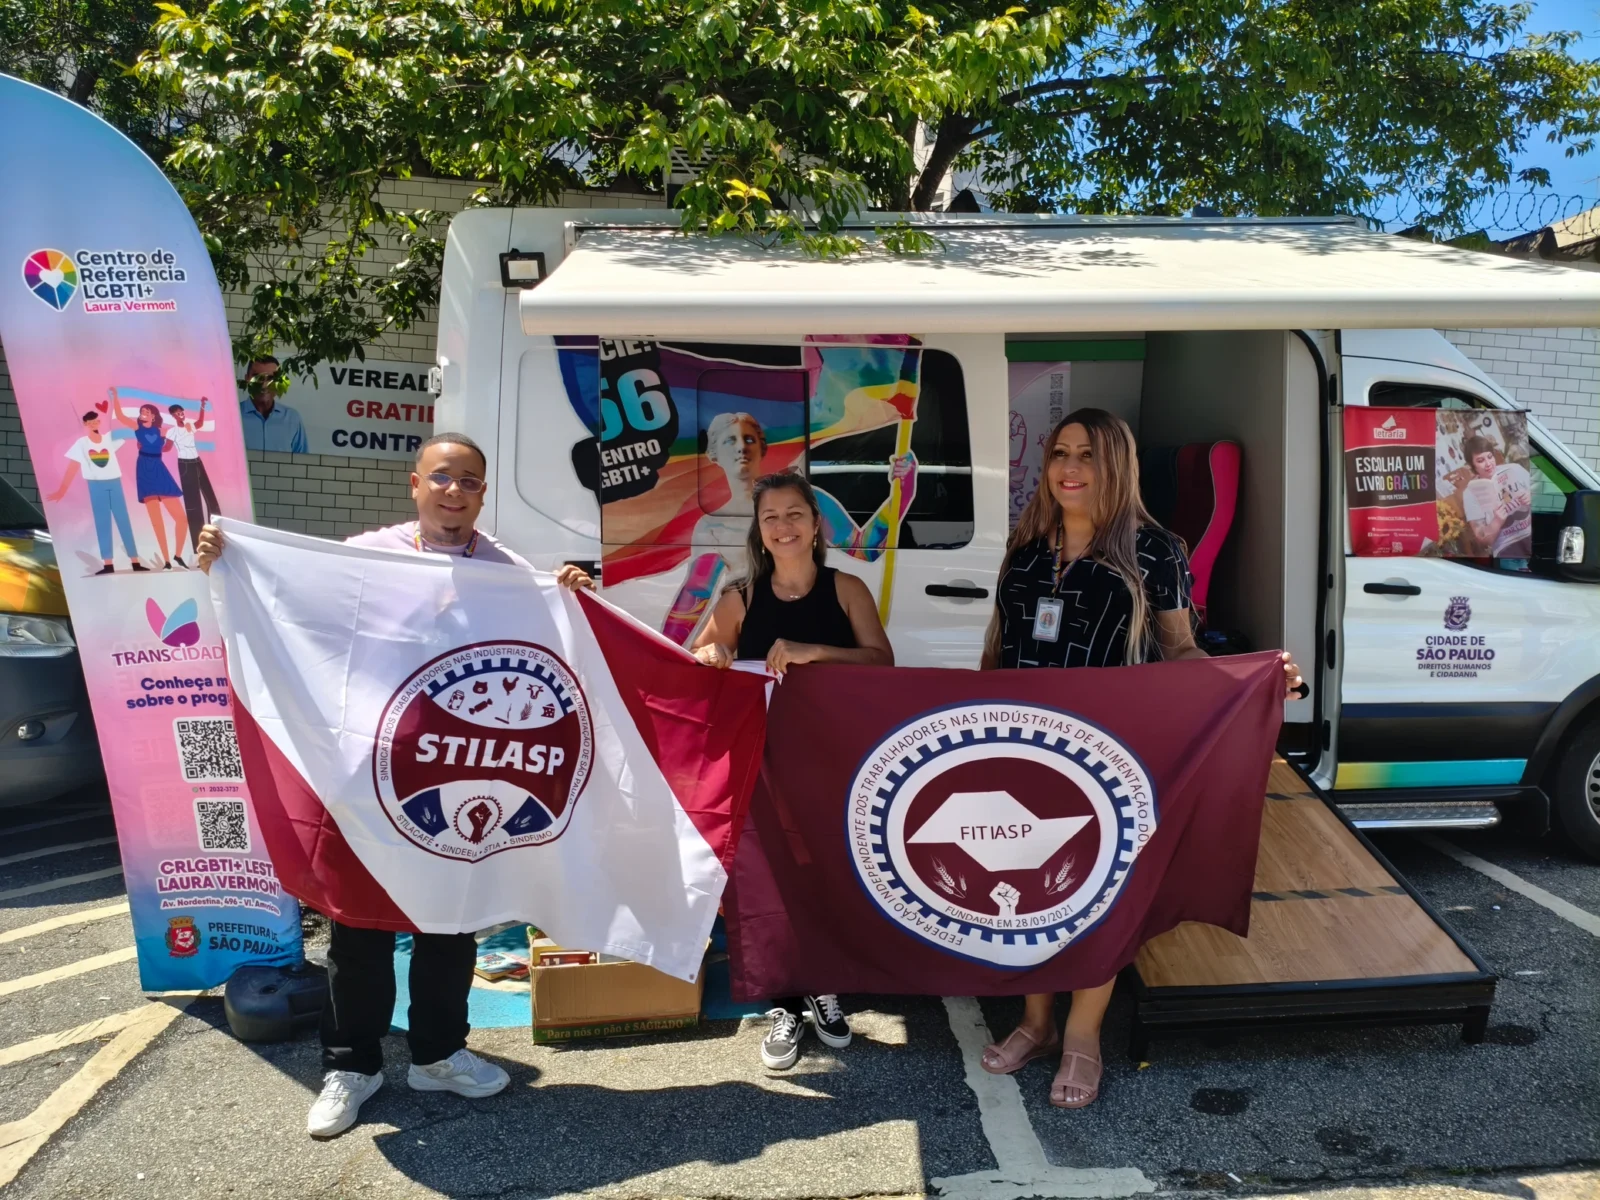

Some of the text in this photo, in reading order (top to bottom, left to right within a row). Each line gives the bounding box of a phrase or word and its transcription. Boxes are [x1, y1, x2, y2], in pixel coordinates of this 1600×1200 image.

[76, 249, 174, 266] Centro de
[80, 265, 186, 282] Referência
[83, 283, 153, 299] LGBTI+
[85, 300, 176, 312] Laura Vermont
[1375, 429, 1404, 438] letraria
[1355, 455, 1425, 473] ESCOLHA UM
[1355, 472, 1428, 492] LIVRO GRÁTIS
[1425, 636, 1485, 646] CIDADE DE
[452, 653, 472, 665] NAS
[474, 646, 526, 659] INDÚSTRIAS
[528, 650, 540, 660] DE
[1416, 646, 1495, 660] SÃO PAULO
[540, 654, 572, 689] LATICÍNIOS
[140, 676, 213, 691] Conheça
[391, 660, 452, 716] TRABALHADORES
[569, 685, 577, 693] E
[126, 693, 229, 709] sobre o prog
[384, 717, 396, 735] DOS
[571, 692, 591, 748] ALIMENTAÇÃO
[380, 736, 390, 781] SINDICATO
[415, 732, 565, 776] STILASP
[581, 747, 589, 760] DE
[576, 759, 588, 777] SÃO
[396, 814, 434, 847] STILACAFÉ
[484, 842, 501, 854] STIA
[509, 831, 553, 845] SINDFUMO
[855, 710, 1150, 946] FEDERAÇÃO INDEPENDENTE DOS TRABALHADORES NAS INDÚSTRIAS DE ALIMENTAÇÃO DO
[960, 823, 1033, 841] FITIASP
[160, 857, 274, 877] CRLGBTI+ LEST
[157, 877, 215, 893] LAURA
[161, 900, 175, 909] Av.
[177, 898, 224, 908] Nordestina,
[224, 898, 238, 906] 496
[944, 904, 1074, 928] FUNDADA EM 28/09/2021
[208, 922, 271, 940] PREFEITURA
[208, 934, 241, 951] SÃO
[574, 1028, 592, 1037] nós
[603, 1025, 622, 1037] pão
[624, 1023, 630, 1032] é
